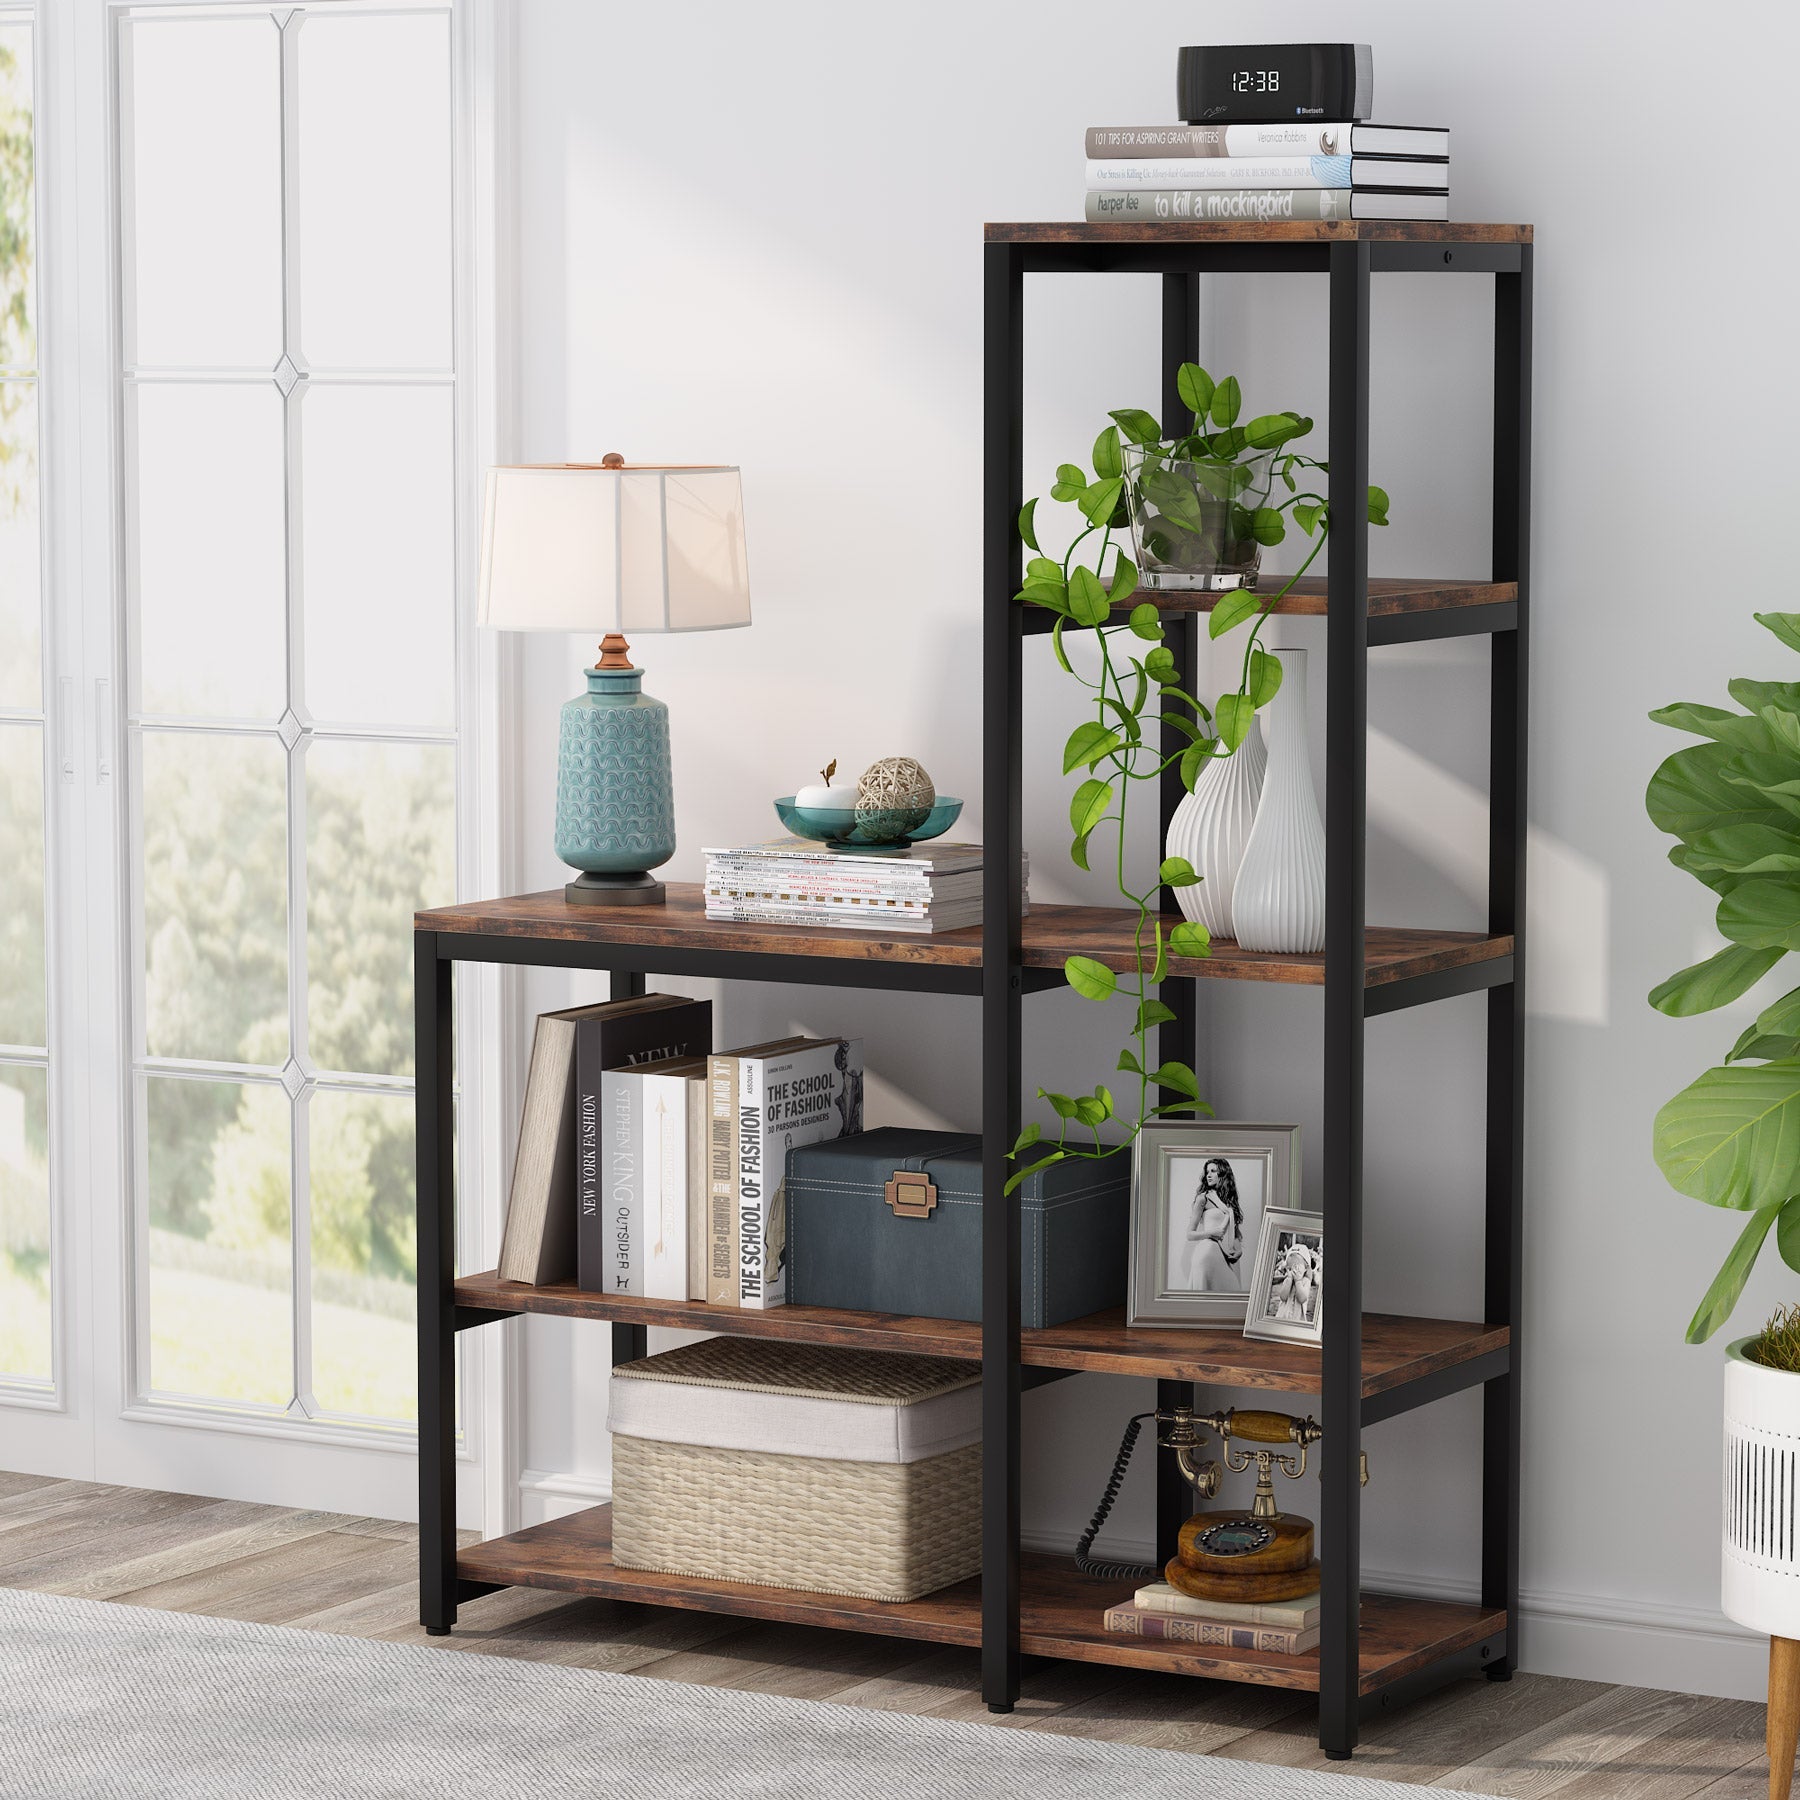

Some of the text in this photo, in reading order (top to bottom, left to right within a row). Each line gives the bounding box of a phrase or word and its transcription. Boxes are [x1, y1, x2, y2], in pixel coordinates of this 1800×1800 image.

[1233, 71, 1279, 92] 12:38
[1301, 107, 1324, 115] Bluetooth
[1095, 131, 1219, 145] 101 TIPS FOR ASPIRING GRANT WRITERS
[1097, 193, 1139, 215] harper lee
[1154, 190, 1294, 221] to kill a mockingbird
[712, 1060, 731, 1078] J.K.
[712, 1079, 731, 1118] ROWLING
[767, 1072, 835, 1102] THE SCHOOL
[767, 1091, 832, 1122] OF FASHION
[712, 1119, 731, 1148] HARRY
[767, 1112, 830, 1135] 30 PARSONS DESIGNERS
[583, 1094, 596, 1216] NEW YORK FASHION
[612, 1088, 634, 1201] STEPHEN KING
[712, 1149, 731, 1180] POTTER
[712, 1195, 731, 1235] CHAMBER
[740, 1105, 761, 1299] THE SCHOOL OF FASHION
[616, 1207, 631, 1270] OUTSIDER
[712, 1243, 731, 1279] SECRETS
